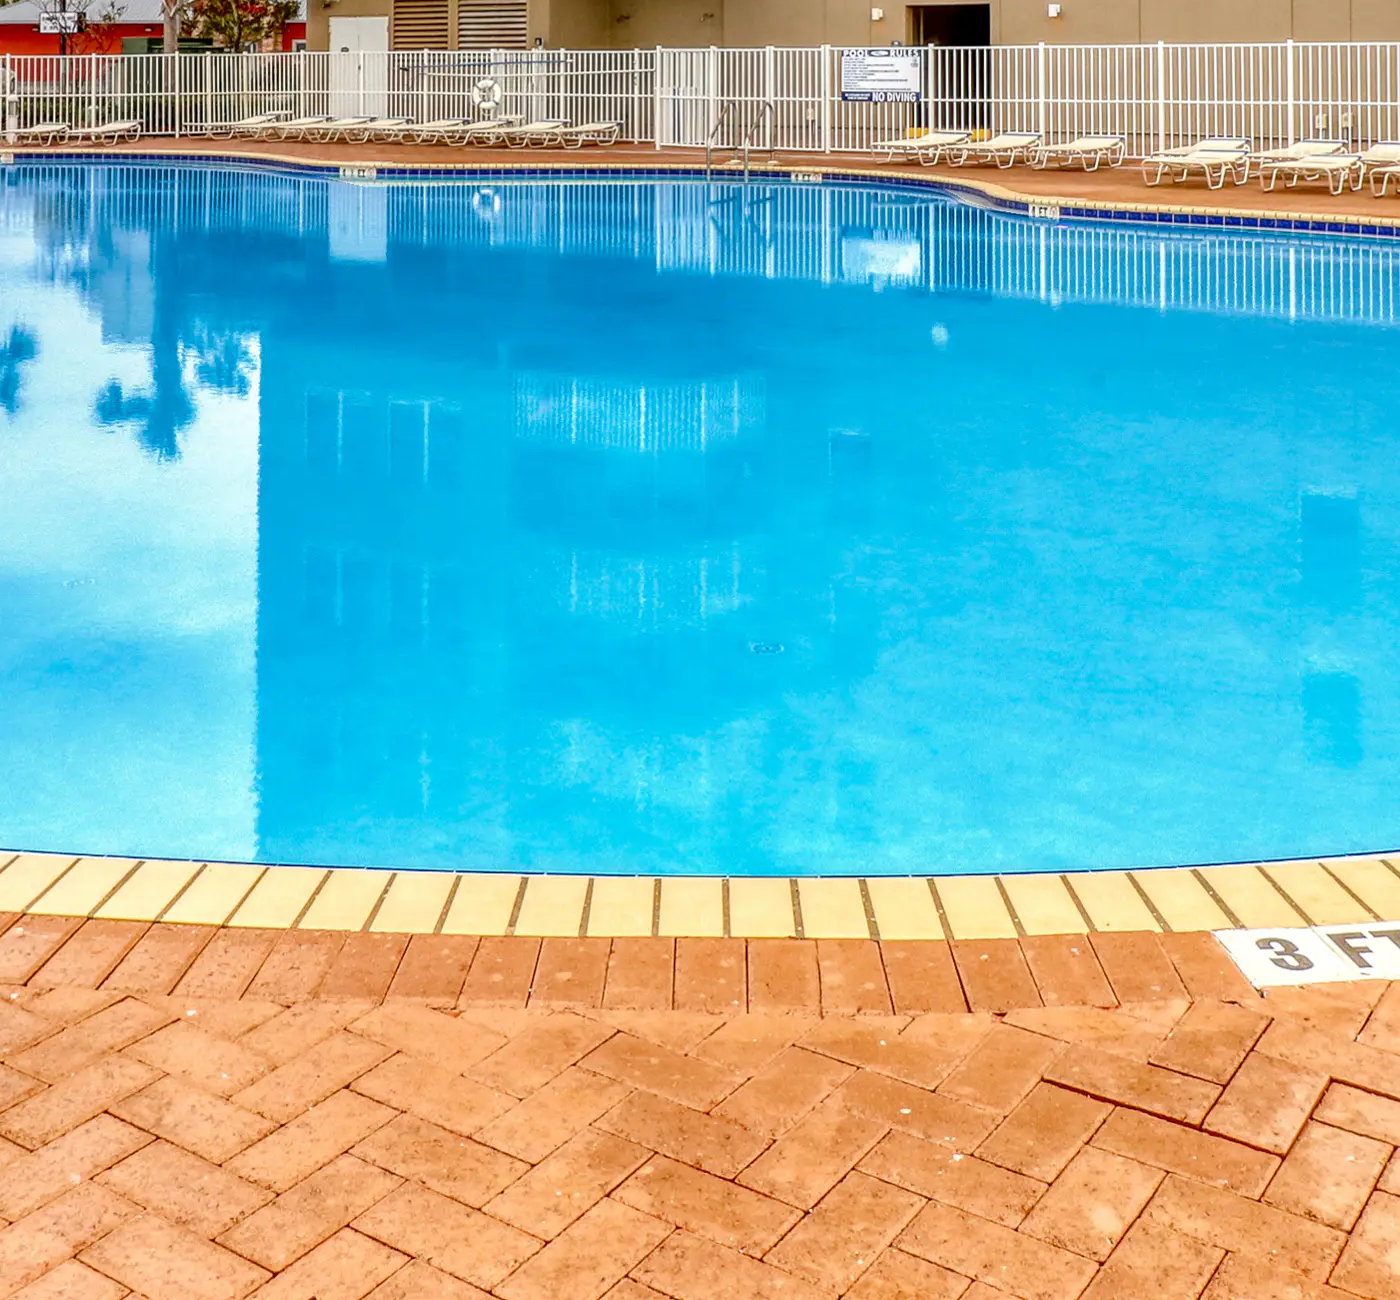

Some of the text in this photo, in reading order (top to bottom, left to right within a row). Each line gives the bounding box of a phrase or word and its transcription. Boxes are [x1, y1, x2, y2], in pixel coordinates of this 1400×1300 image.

[843, 49, 919, 57] POOL RULES
[872, 92, 885, 102] NO
[887, 92, 917, 102] DIVING
[1255, 937, 1314, 971] 3
